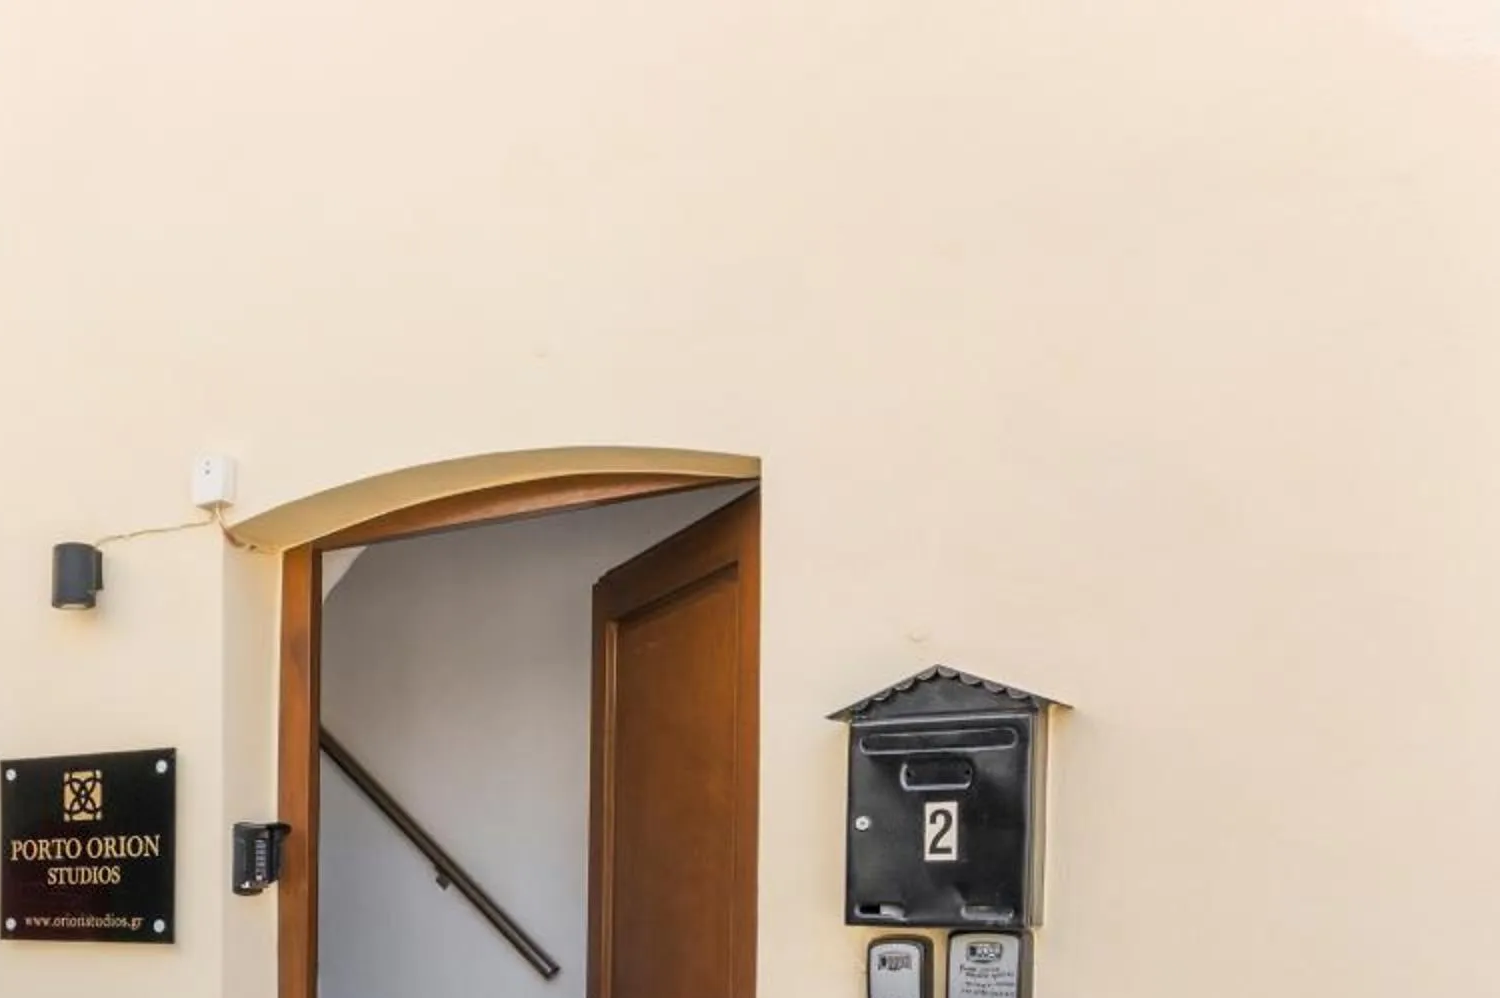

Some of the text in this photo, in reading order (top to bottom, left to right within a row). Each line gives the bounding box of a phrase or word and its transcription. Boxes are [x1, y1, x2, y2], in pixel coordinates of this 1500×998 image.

[928, 808, 953, 855] 2
[11, 834, 161, 861] PORTO ORION
[47, 866, 121, 885] STUDIOS
